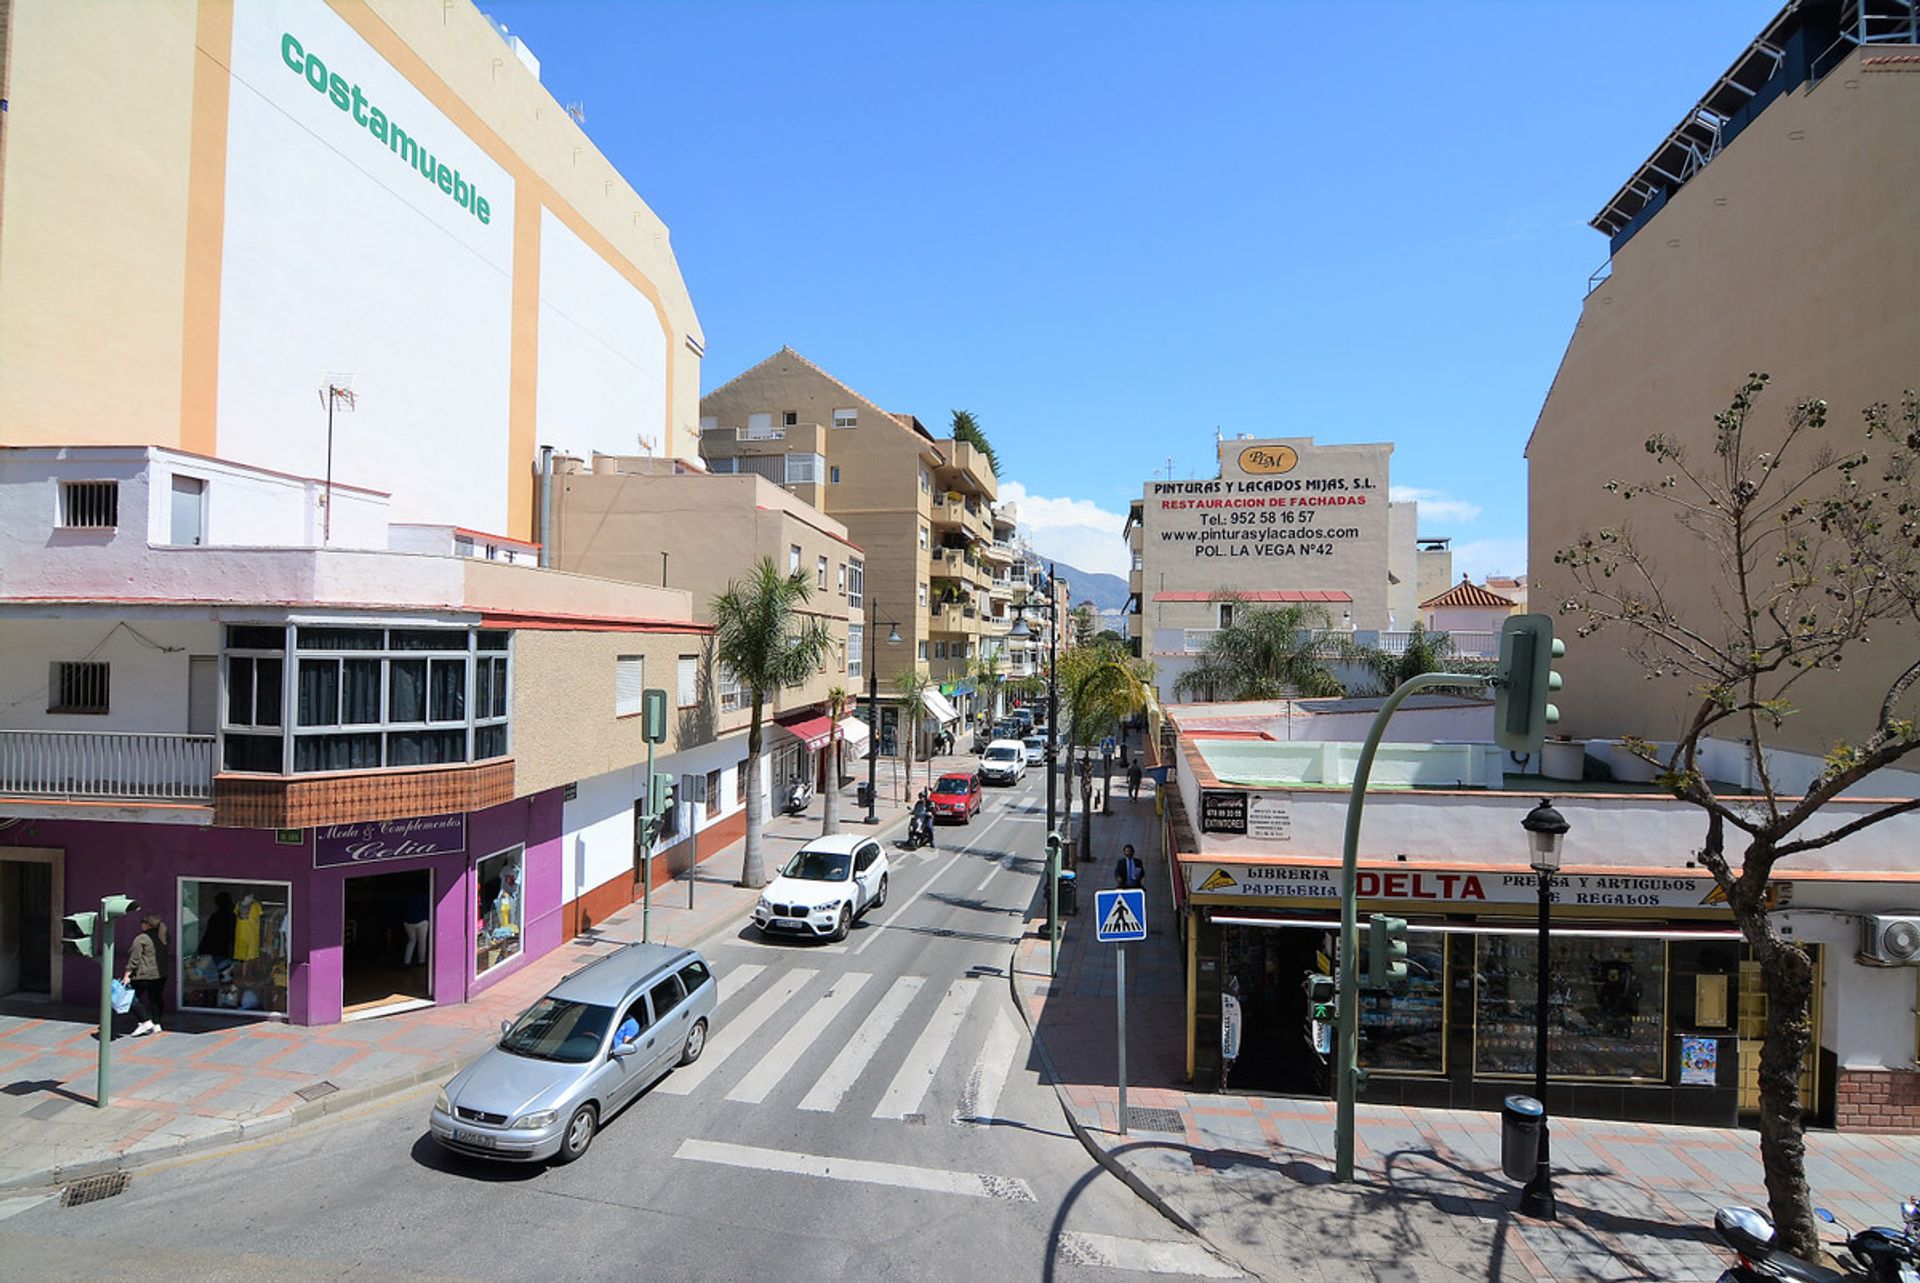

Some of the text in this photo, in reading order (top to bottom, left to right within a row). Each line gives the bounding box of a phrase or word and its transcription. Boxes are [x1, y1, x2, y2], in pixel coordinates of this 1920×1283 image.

[281, 32, 491, 225] costamueble
[1154, 478, 1376, 494] PINTURAS Y LACADOS MIJAS, S.L.
[1161, 495, 1367, 510] RESTAURACION DE FACHADAS
[1230, 512, 1256, 525] 952
[1259, 512, 1276, 524] 58
[1280, 511, 1294, 523] 16
[1298, 511, 1315, 523] 57
[1161, 527, 1359, 542] www.pinturasylacados.com
[1195, 545, 1227, 557] POL.
[1230, 545, 1249, 556] LA
[1254, 544, 1296, 556] VEGA
[318, 826, 359, 840] Moda
[363, 824, 373, 841] &
[379, 817, 462, 836] Complementos
[345, 840, 438, 861] Celia
[1247, 867, 1330, 881] LIBRERIA
[1503, 875, 1570, 887] PRESA
[1579, 877, 1594, 888] Y
[1241, 883, 1338, 896] PAPELERIA
[1356, 872, 1486, 900] DELTA
[1577, 892, 1661, 905] REGALOS
